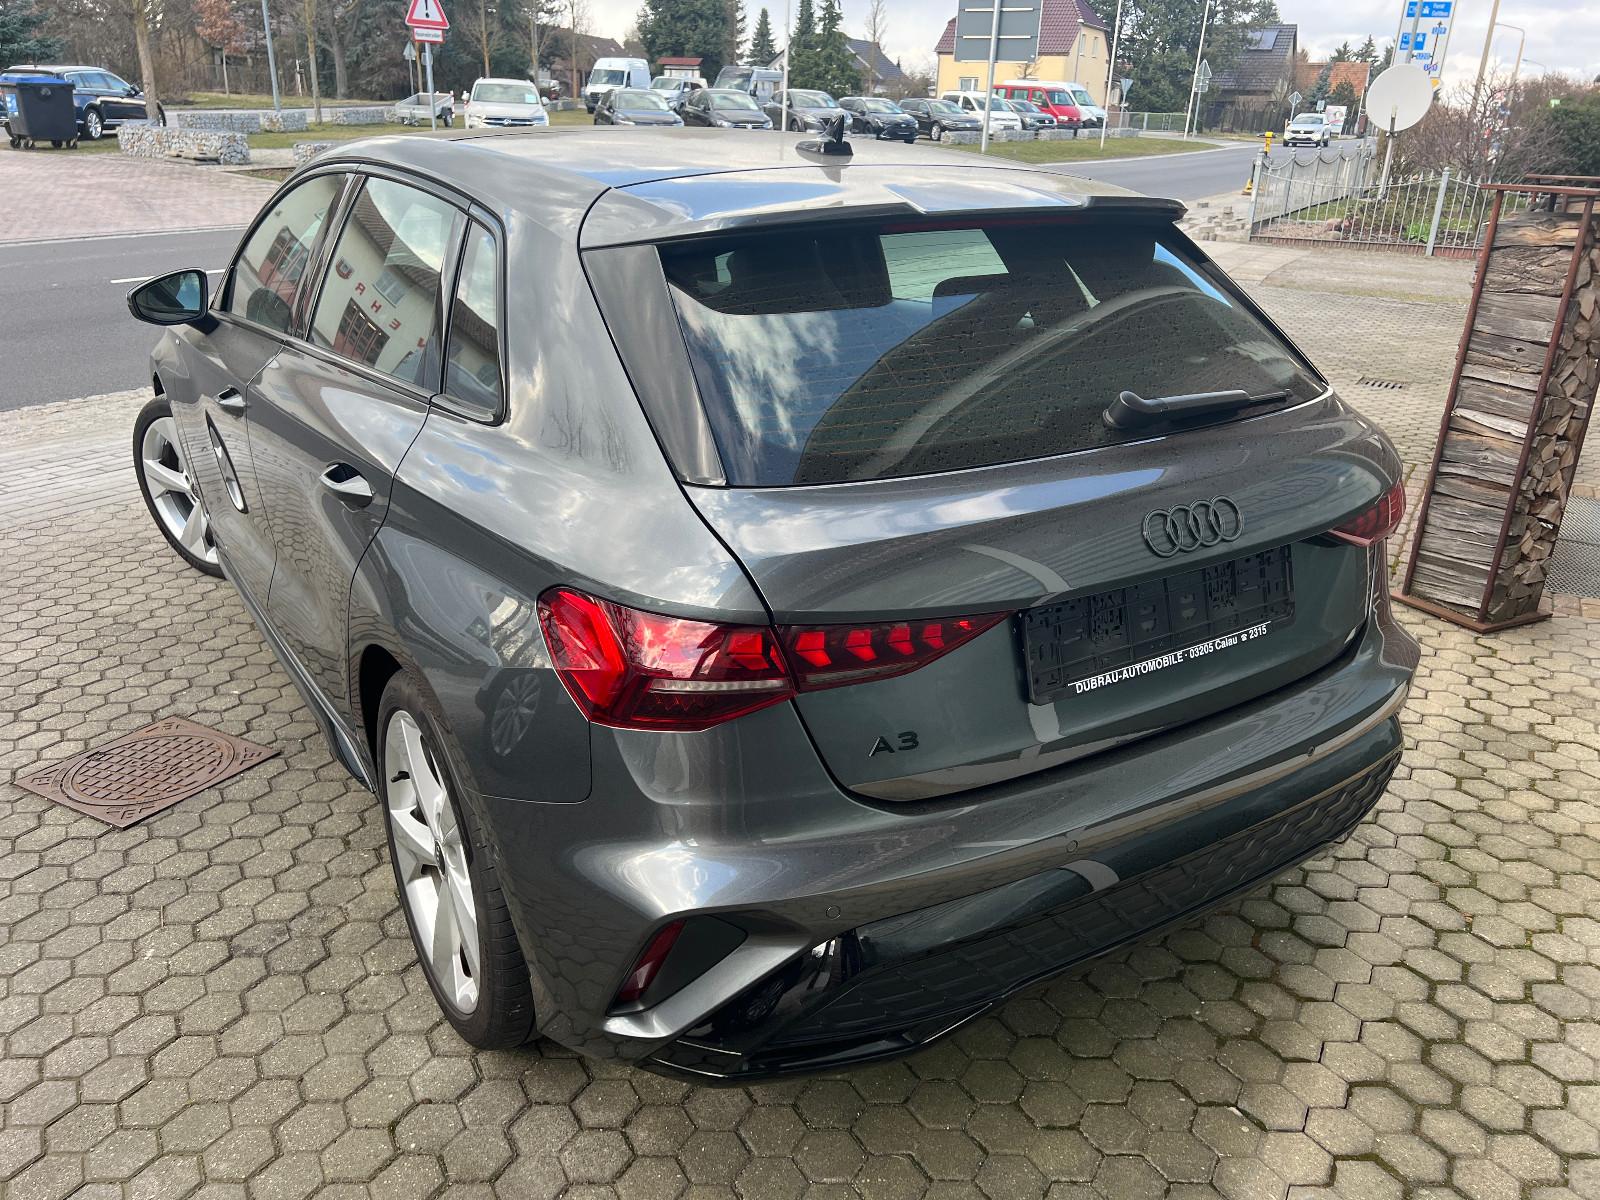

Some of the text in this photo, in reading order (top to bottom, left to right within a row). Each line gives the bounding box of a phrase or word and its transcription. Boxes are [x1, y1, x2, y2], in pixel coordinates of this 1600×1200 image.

[1075, 624, 1267, 694] DUBRAU-AUTOMOBILE 03205 Calau 2315
[868, 731, 919, 757] A3
